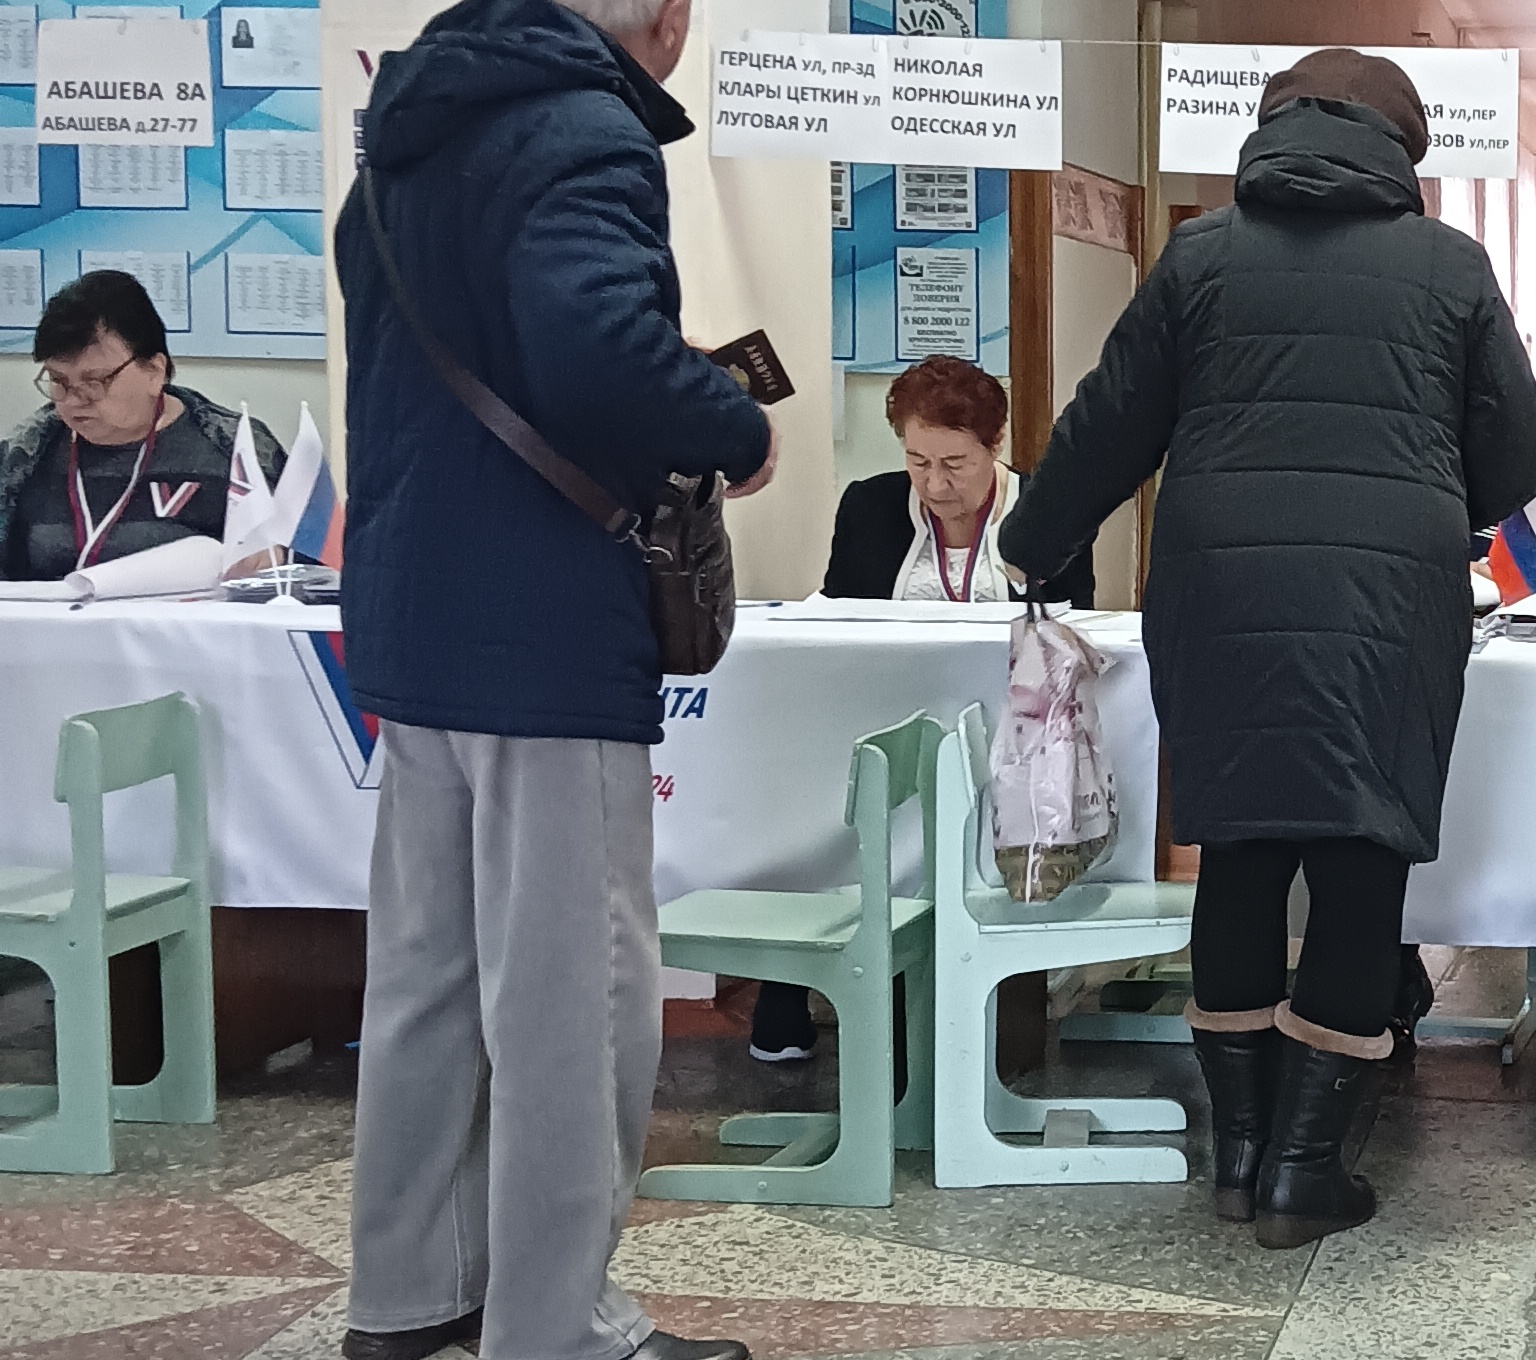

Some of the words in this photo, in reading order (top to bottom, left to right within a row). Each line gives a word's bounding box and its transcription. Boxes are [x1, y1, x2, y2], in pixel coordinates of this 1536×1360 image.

[719, 50, 797, 71] ГЕРЦЕНА
[893, 57, 983, 78] НИКОЛАЯ
[1167, 67, 1272, 89] РАДИЩЕВА
[47, 80, 164, 101] АБАШЕВА
[176, 82, 207, 101] 8А
[718, 80, 781, 99] КЛАРЫ
[786, 85, 858, 105] ЦЕТКИН
[892, 85, 1031, 110] КОРНЮШКИНА
[1036, 95, 1059, 111] УЛ
[1166, 97, 1240, 117] РАЗИНА
[41, 116, 131, 132] АБАШЕВА
[716, 110, 799, 131] ЛУГОВАЯ
[804, 116, 828, 133] УЛ
[891, 115, 987, 137] ОДЕССКАЯ
[992, 122, 1017, 139] УЛ
